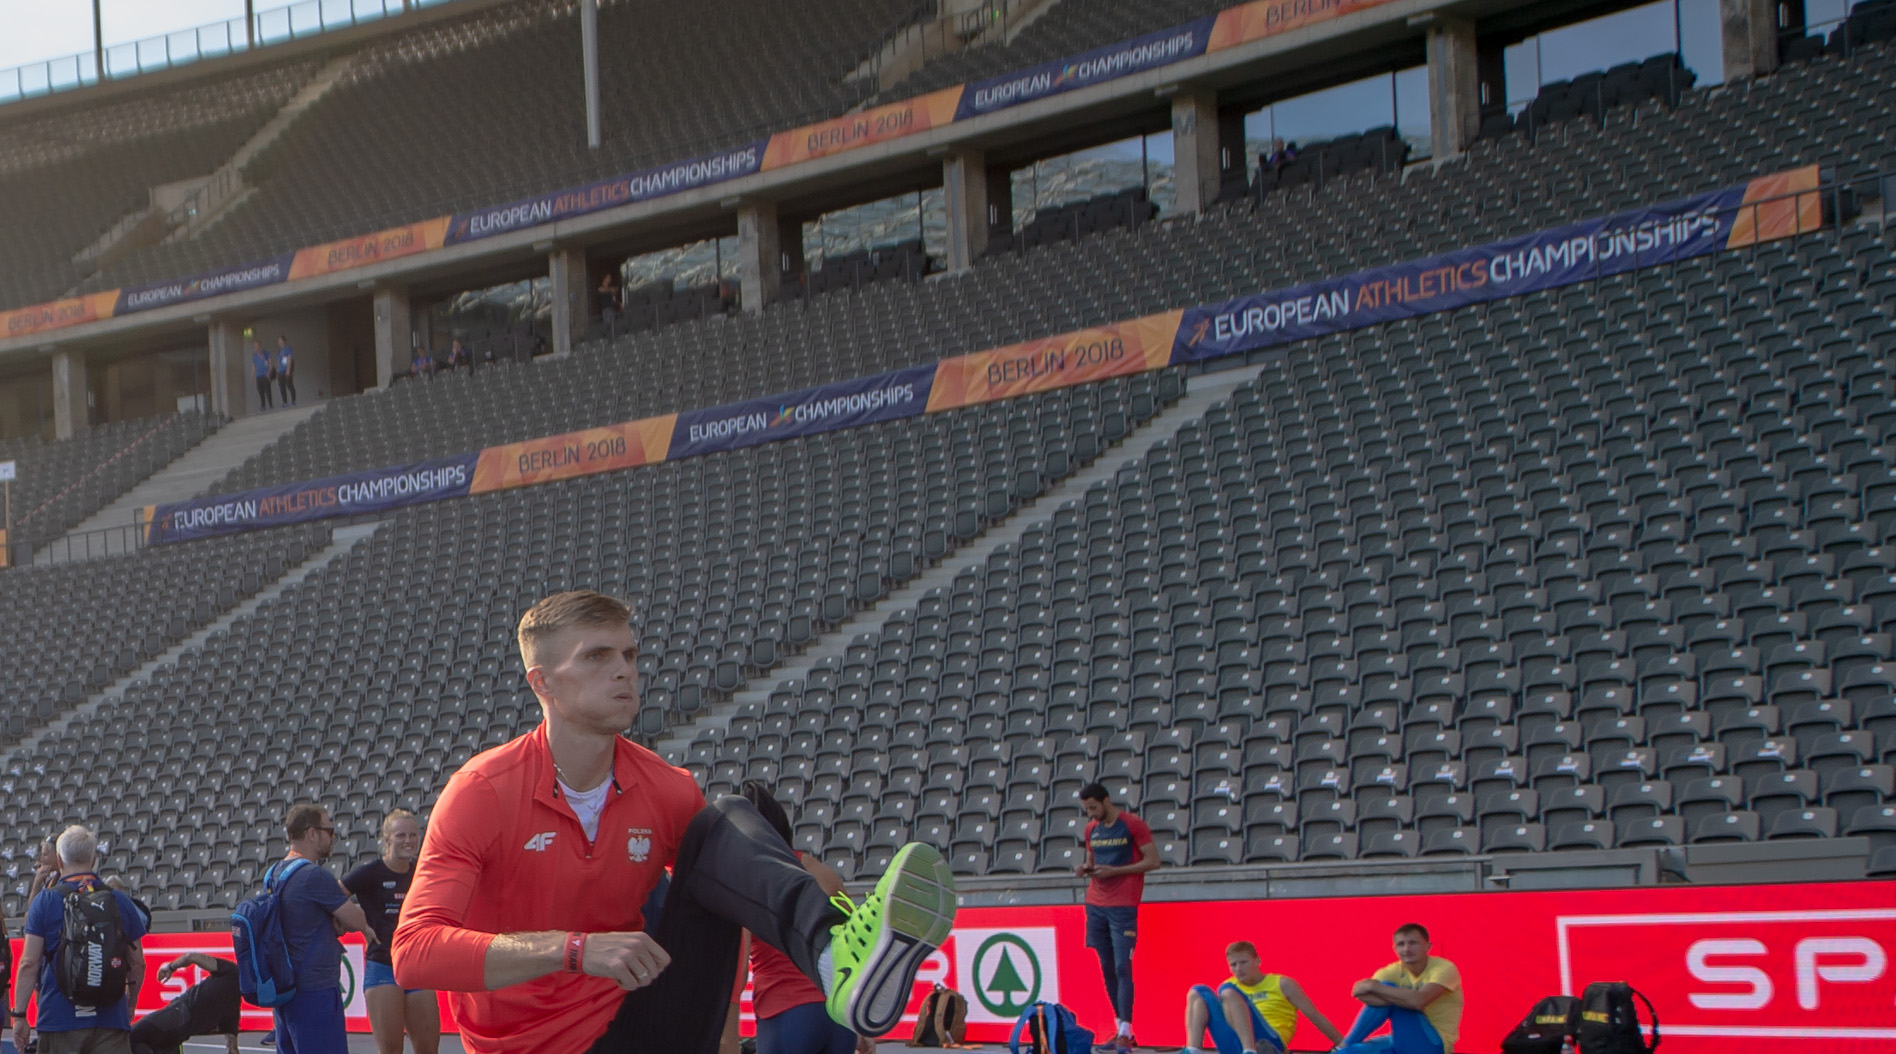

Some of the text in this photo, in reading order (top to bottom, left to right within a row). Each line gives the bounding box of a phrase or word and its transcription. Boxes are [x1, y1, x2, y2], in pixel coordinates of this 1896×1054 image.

[975, 31, 1194, 108] EUROPEAN CHAMPIONSHIPS
[807, 108, 913, 151] BERLIN 2018
[470, 148, 756, 234] EUROPEAN ATHLETICS CHAMPIONSHIPS
[328, 240, 380, 264] BERLIN
[1215, 205, 1720, 342] EUROPEAN ATHLETICS CHAMPIONSHIPS
[128, 263, 280, 305] EUROPEAN CHAMPIONSHIPS
[987, 338, 1125, 386] BERLIN 2018
[689, 384, 914, 443] EUROPEAN CHAMPIONSHIPS
[518, 437, 627, 474] BERLIN 2018
[174, 464, 466, 531] EUROPEAN ATHLETICS CHAMPIONSHIPS
[87, 940, 103, 987] NORWAY
